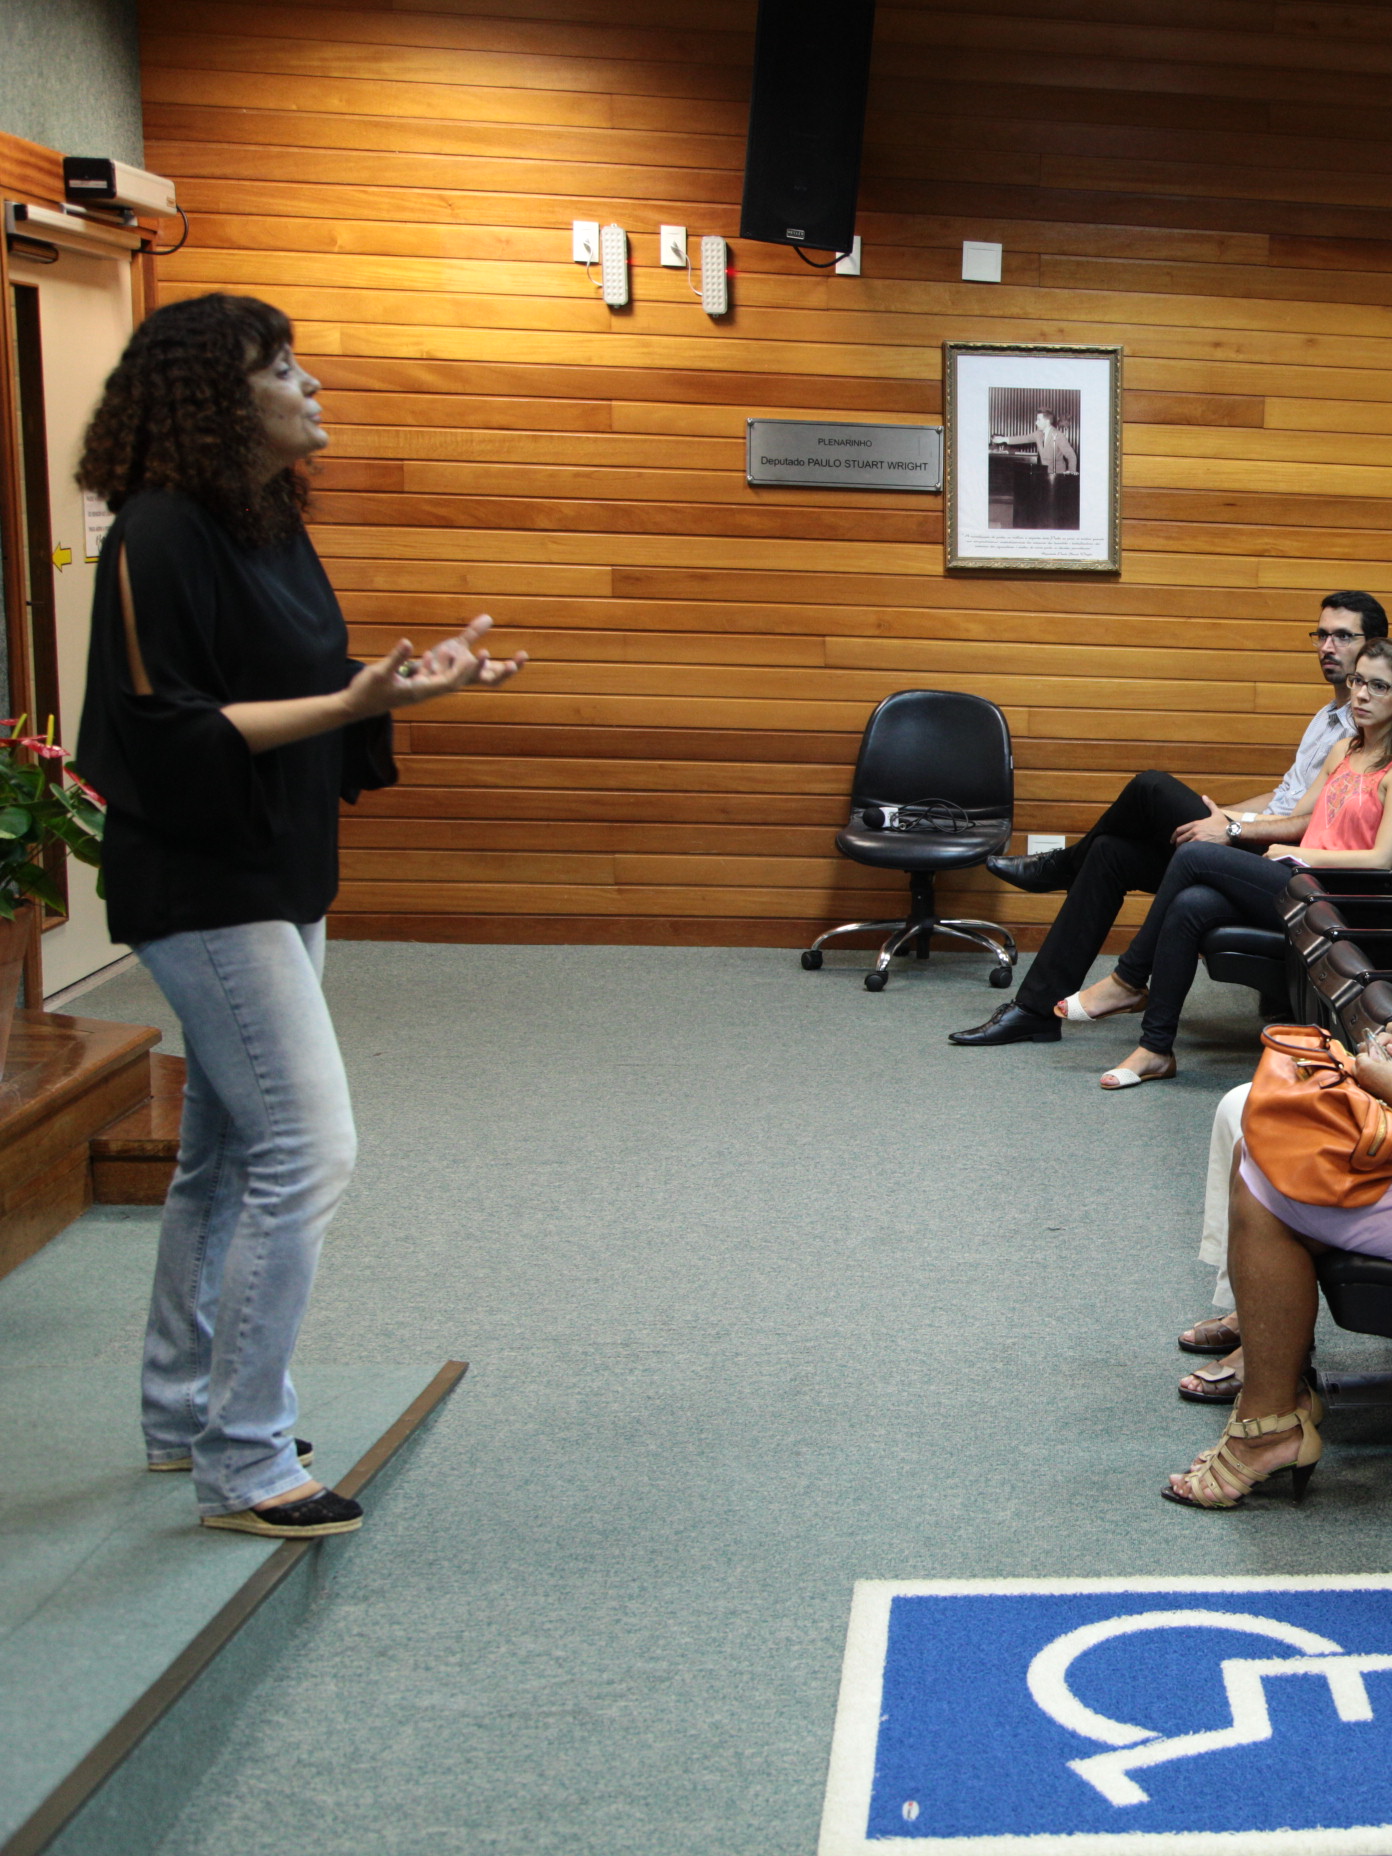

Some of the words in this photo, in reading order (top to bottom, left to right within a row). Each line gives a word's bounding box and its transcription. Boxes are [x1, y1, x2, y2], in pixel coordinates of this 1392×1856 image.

[817, 438, 873, 448] PLENARINHO
[760, 456, 805, 467] Deputado
[807, 458, 842, 468] PAULO
[844, 459, 885, 470] STUART
[887, 462, 929, 471] WRIGHT
